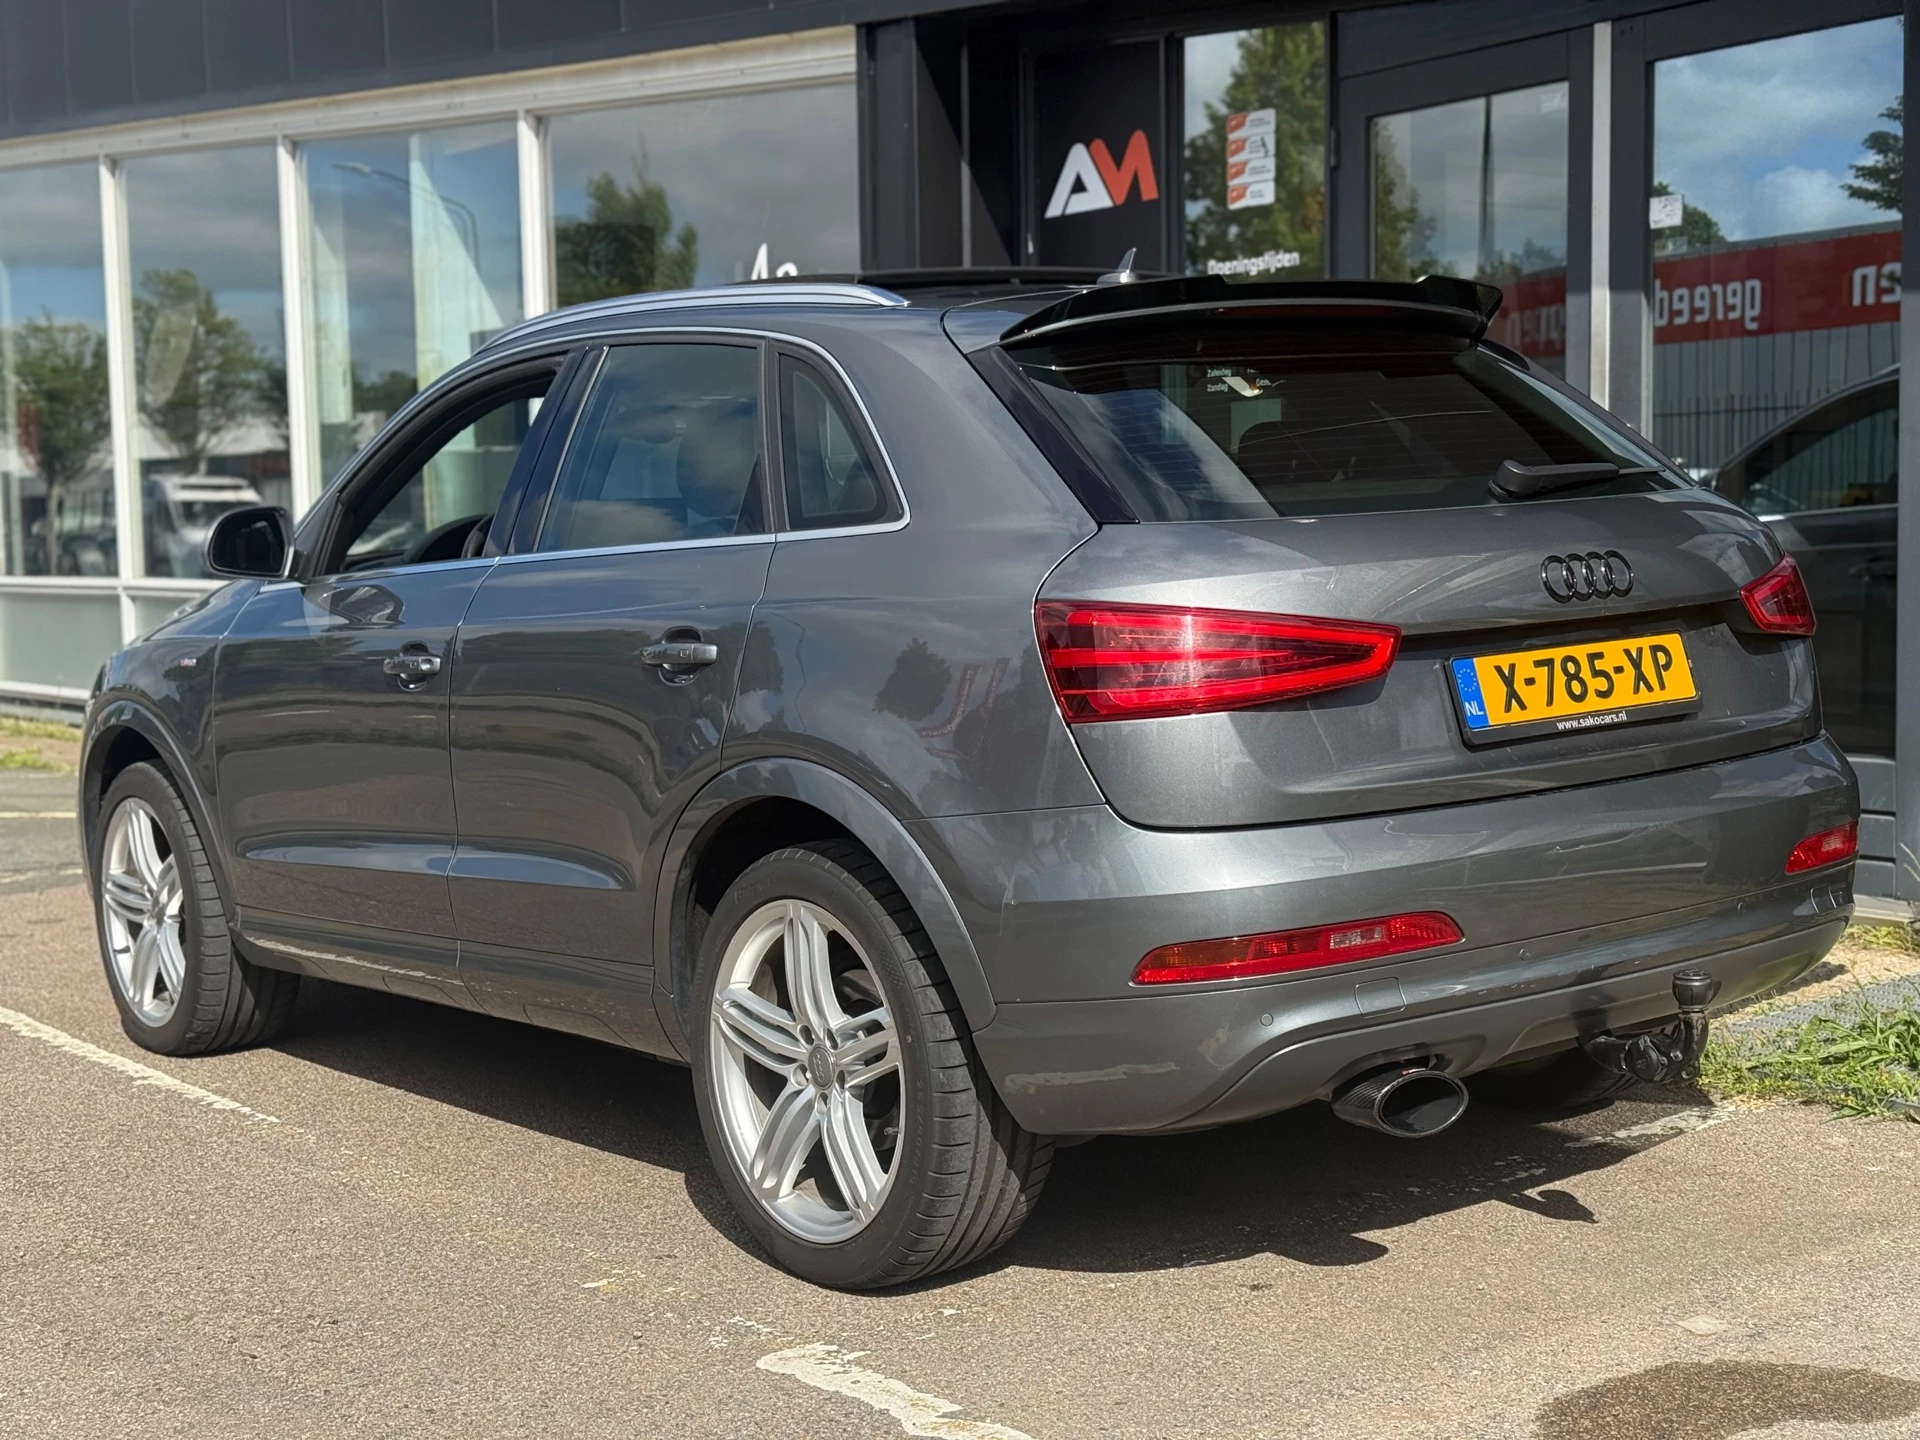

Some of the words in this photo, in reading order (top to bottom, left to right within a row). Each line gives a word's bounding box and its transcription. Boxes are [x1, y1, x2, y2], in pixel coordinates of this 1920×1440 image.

[1044, 129, 1159, 219] AM
[1494, 644, 1673, 713] X-785-XP
[1465, 701, 1484, 716] NL
[1556, 710, 1628, 731] www.sakocars.nl
